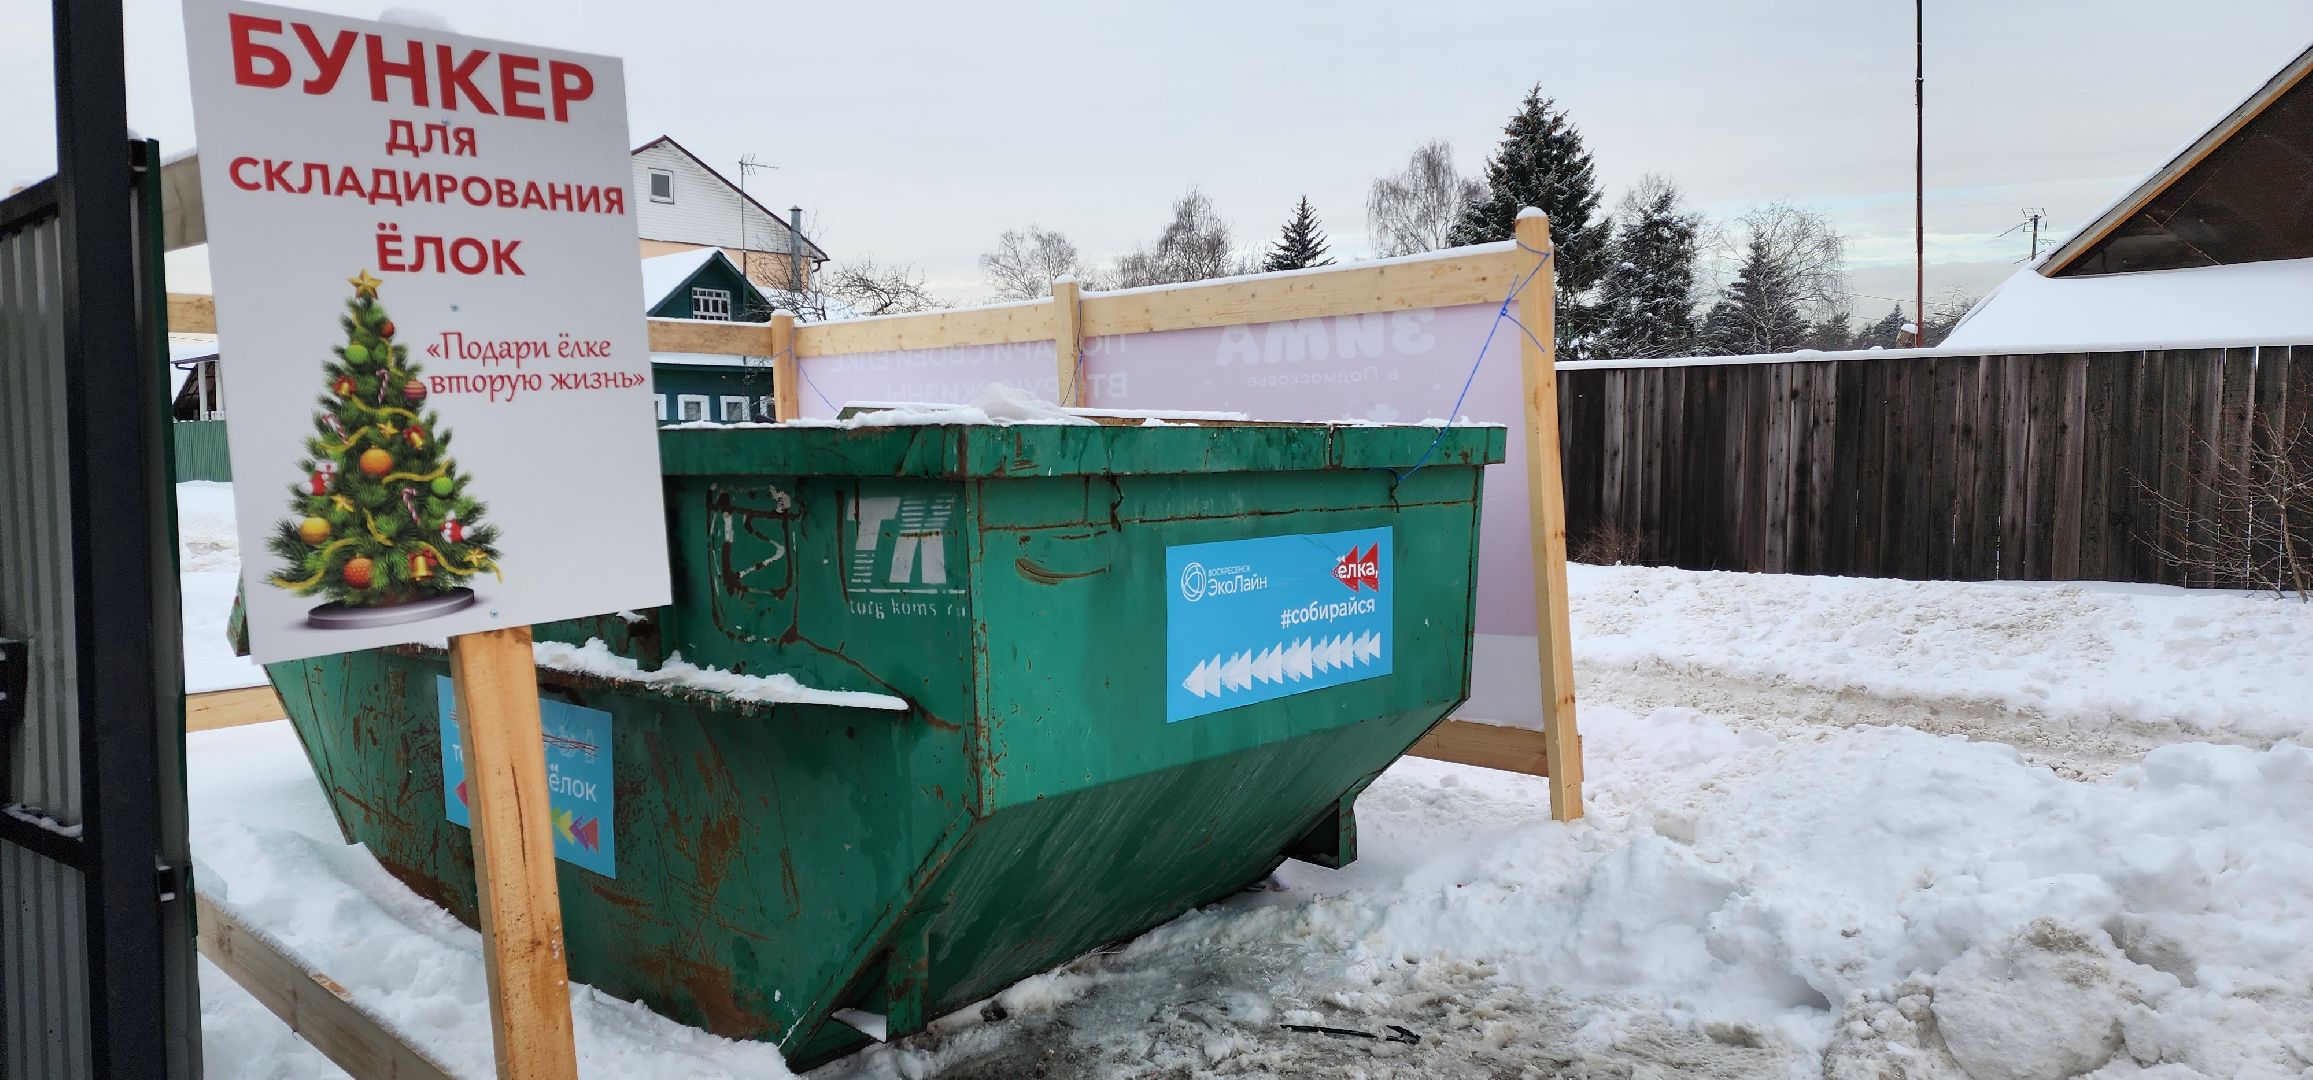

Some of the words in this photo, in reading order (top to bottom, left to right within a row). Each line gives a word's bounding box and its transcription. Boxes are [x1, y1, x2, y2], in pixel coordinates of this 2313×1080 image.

[229, 13, 594, 123] БУНКЕР
[386, 119, 477, 158] ДЛЯ
[229, 157, 625, 215] СКЛАДИРОВАНИЯ
[375, 222, 526, 276] ЁЛОК
[426, 331, 550, 369] «Подари
[557, 332, 611, 358] ёлке
[428, 372, 542, 402] вторую
[549, 370, 645, 391] жизнь»
[1208, 573, 1268, 597] ЭкоЛайн
[1280, 596, 1376, 629] #собирайся
[548, 763, 597, 803] ёлок
